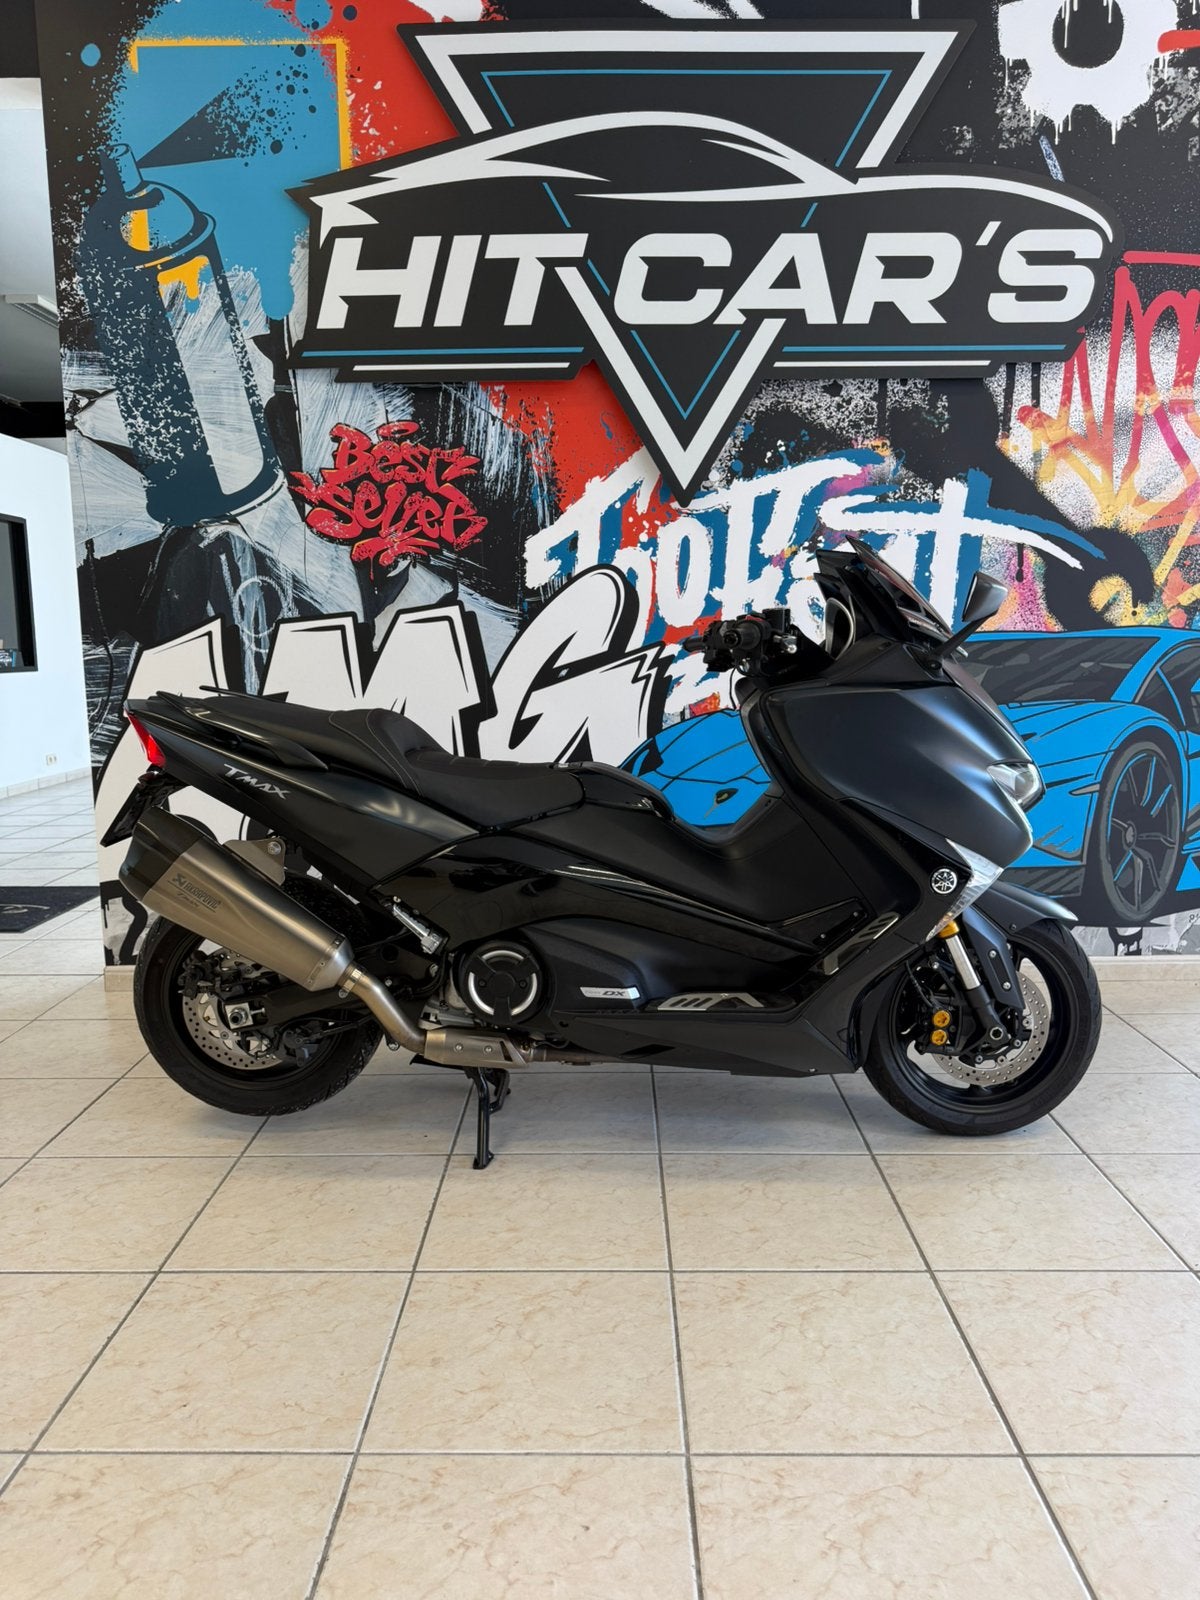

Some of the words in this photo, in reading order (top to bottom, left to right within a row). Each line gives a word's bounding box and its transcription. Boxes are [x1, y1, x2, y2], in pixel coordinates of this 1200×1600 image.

[315, 233, 589, 330] HIT
[613, 222, 1105, 327] CAR'S
[223, 763, 291, 800] TMAX
